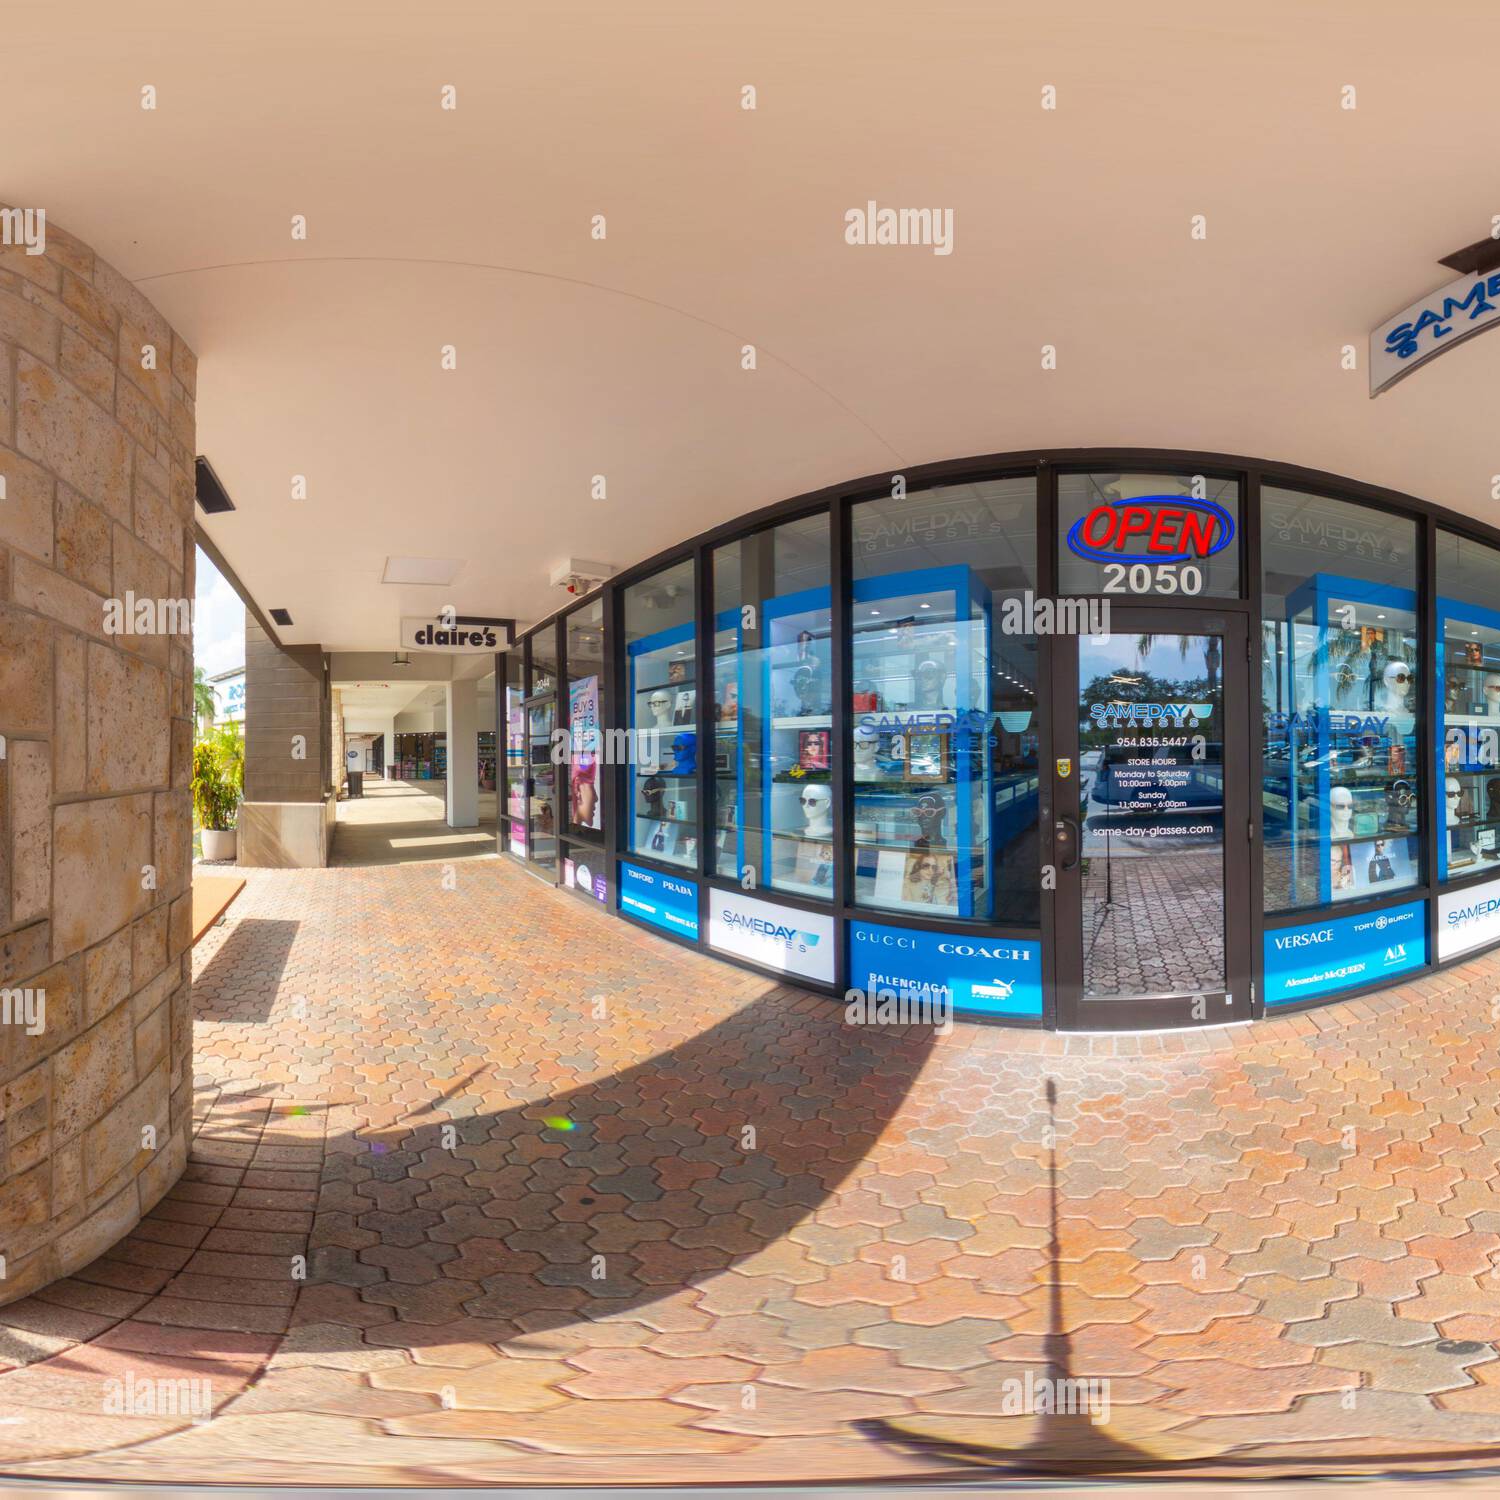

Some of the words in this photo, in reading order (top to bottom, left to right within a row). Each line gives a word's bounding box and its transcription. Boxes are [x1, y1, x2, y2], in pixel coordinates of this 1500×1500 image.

[1082, 505, 1216, 558] OPEN
[1102, 563, 1203, 596] 2050
[415, 626, 497, 648] claire's
[573, 702, 588, 714] BUY
[588, 700, 594, 711] 3
[1090, 703, 1187, 719] SAMEDAY
[1097, 717, 1200, 728] GLASSES
[1116, 737, 1188, 748] 954.835.5447
[1127, 758, 1150, 766] STORE
[1151, 758, 1177, 766] HOURS
[1114, 770, 1146, 779] Monday
[1156, 770, 1190, 779] Saturday
[1118, 780, 1152, 788] 10:00am
[1158, 779, 1187, 788] 7:00pm
[1138, 791, 1167, 800] Sunday
[1092, 824, 1214, 838] same-day-glasses.com
[662, 880, 693, 897] PRADA
[722, 910, 797, 941] SAMEDAY
[1353, 921, 1375, 932] TORY
[1387, 912, 1414, 925] BURCH
[855, 930, 916, 950] GUCCI
[1274, 928, 1334, 950] VERSACE
[938, 943, 1031, 961] COACH
[868, 972, 949, 995] BALENCIAGA
